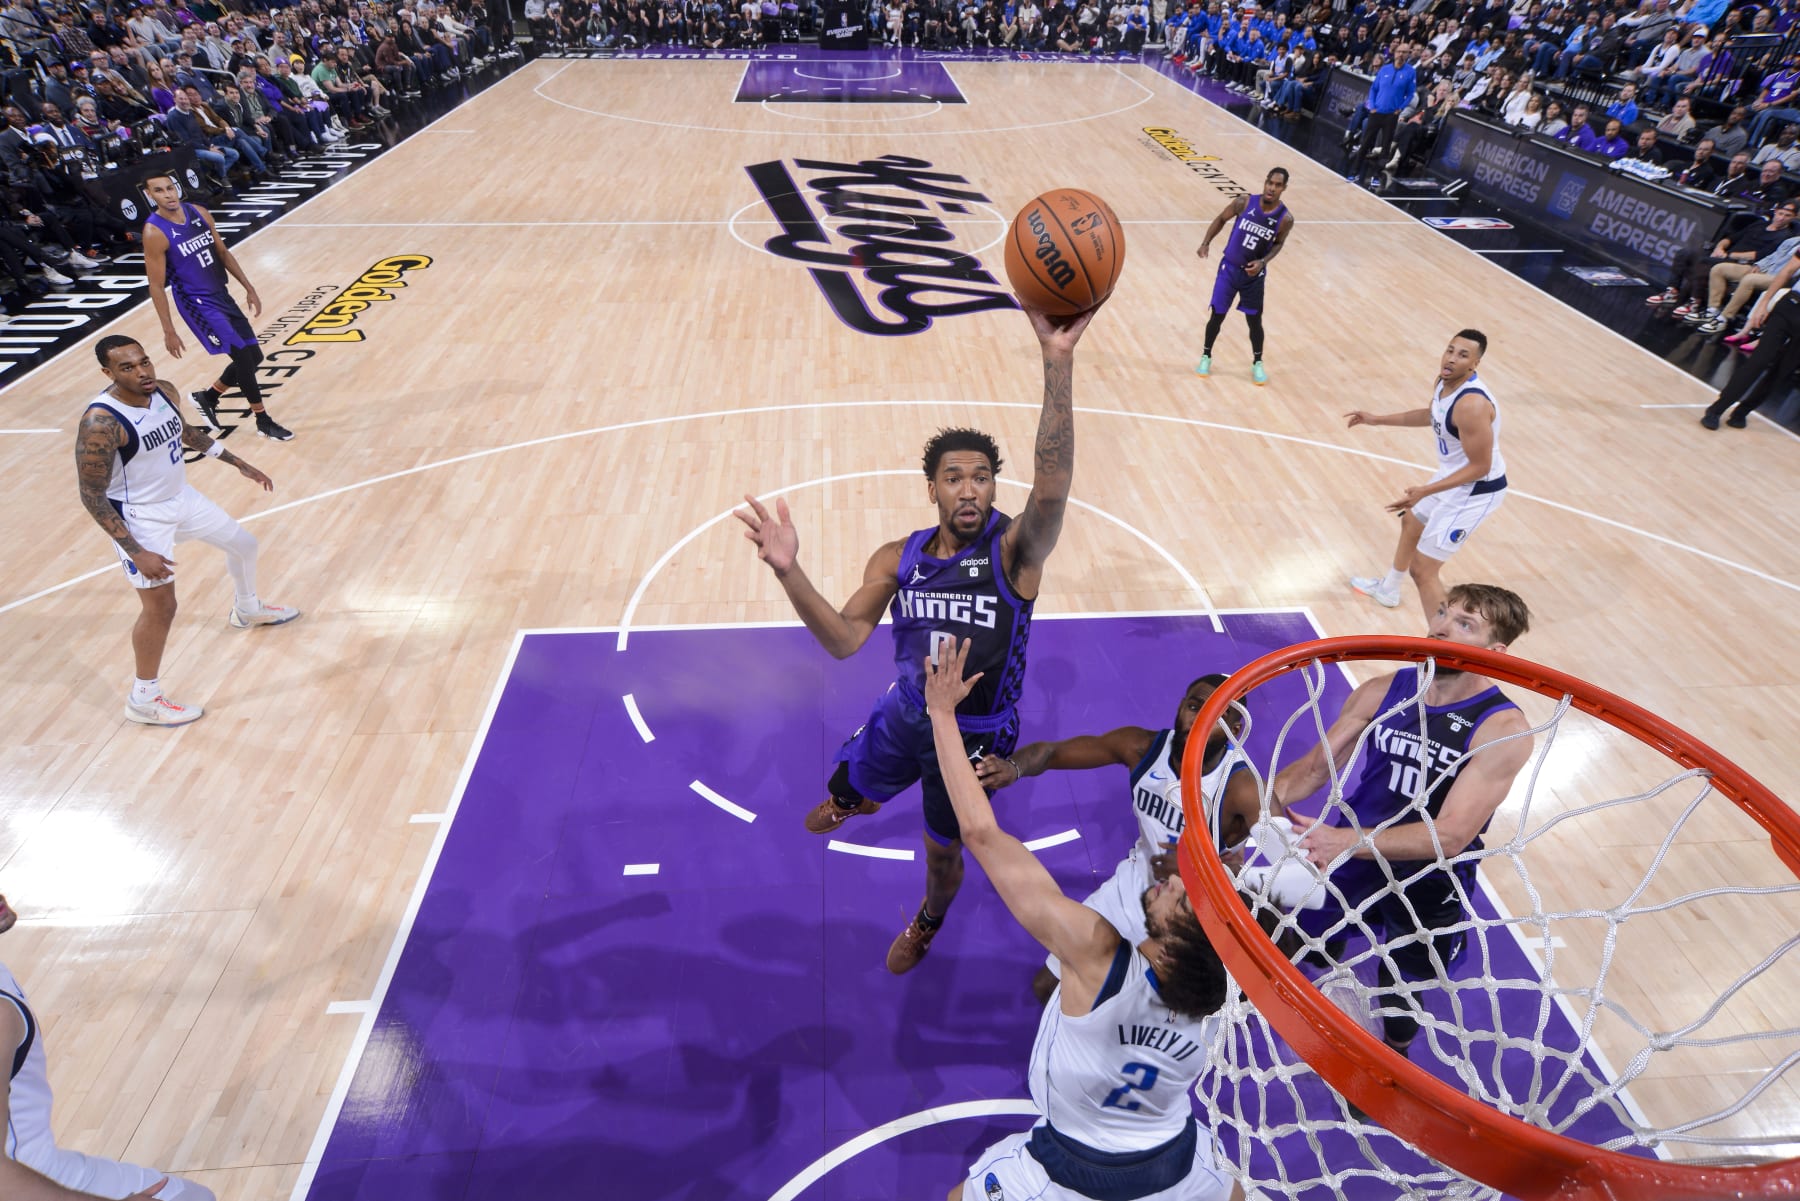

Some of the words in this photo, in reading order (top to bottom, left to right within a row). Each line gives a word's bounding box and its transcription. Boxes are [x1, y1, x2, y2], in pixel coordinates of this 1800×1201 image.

[1327, 81, 1367, 105] AMERICA
[1471, 139, 1549, 183] AMERICAN
[1473, 163, 1541, 204] EXPRESS
[121, 203, 138, 218] TNT
[1589, 186, 1697, 243] AMERICAN
[196, 249, 214, 268] 13
[1028, 208, 1076, 290] Wilson
[1242, 233, 1260, 251] 15
[287, 285, 340, 314] Credit
[256, 313, 305, 346] Union
[141, 415, 181, 451] DALLAS
[959, 556, 989, 568] dialpad
[915, 591, 973, 601] SACRAMENTO
[1388, 760, 1423, 799] 10
[1137, 787, 1186, 833] DALL
[1118, 1023, 1182, 1053] LIVELY
[1172, 1040, 1199, 1062] II
[1101, 1061, 1160, 1112] 2
